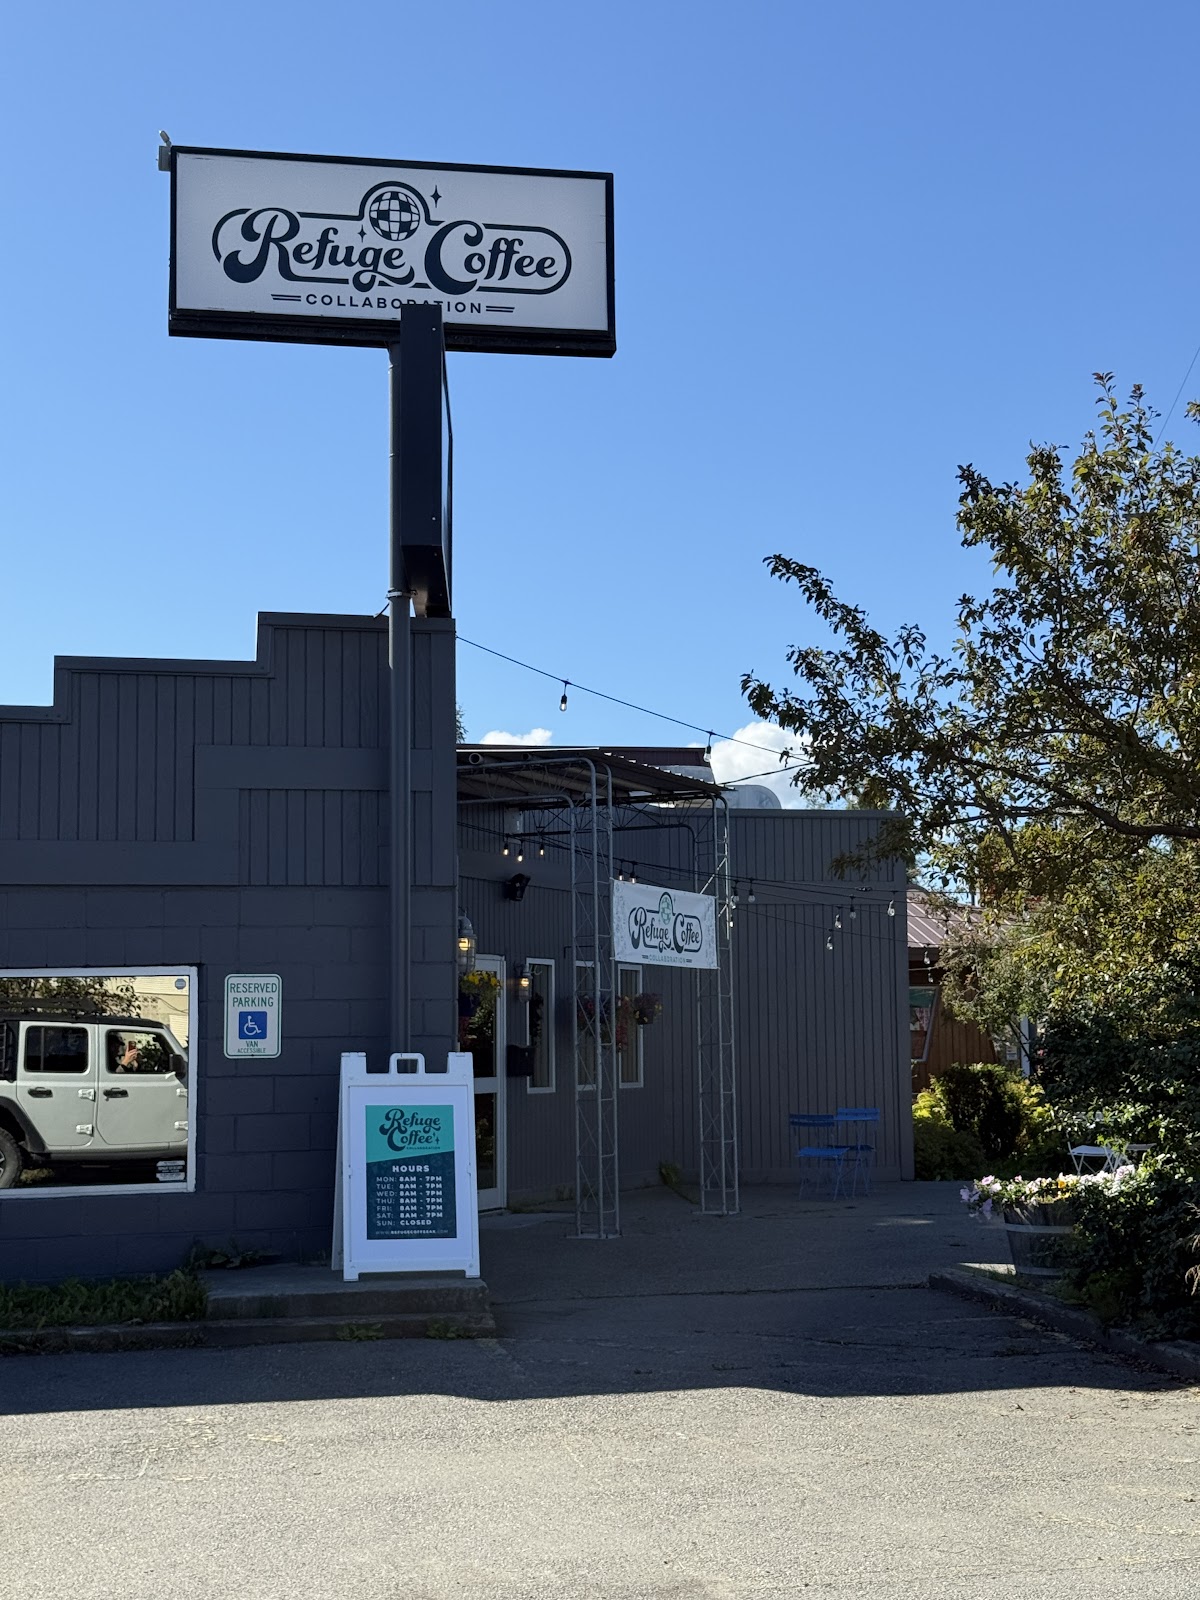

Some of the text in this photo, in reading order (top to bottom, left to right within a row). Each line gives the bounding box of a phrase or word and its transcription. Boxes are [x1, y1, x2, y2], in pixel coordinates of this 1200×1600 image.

[223, 207, 558, 295] Refuge Coffee
[631, 906, 699, 953] Refuge Coffee
[229, 983, 278, 993] RESERVED
[232, 997, 274, 1007] PARKING
[379, 1108, 441, 1135] Refuge
[387, 1126, 433, 1152] Coffee
